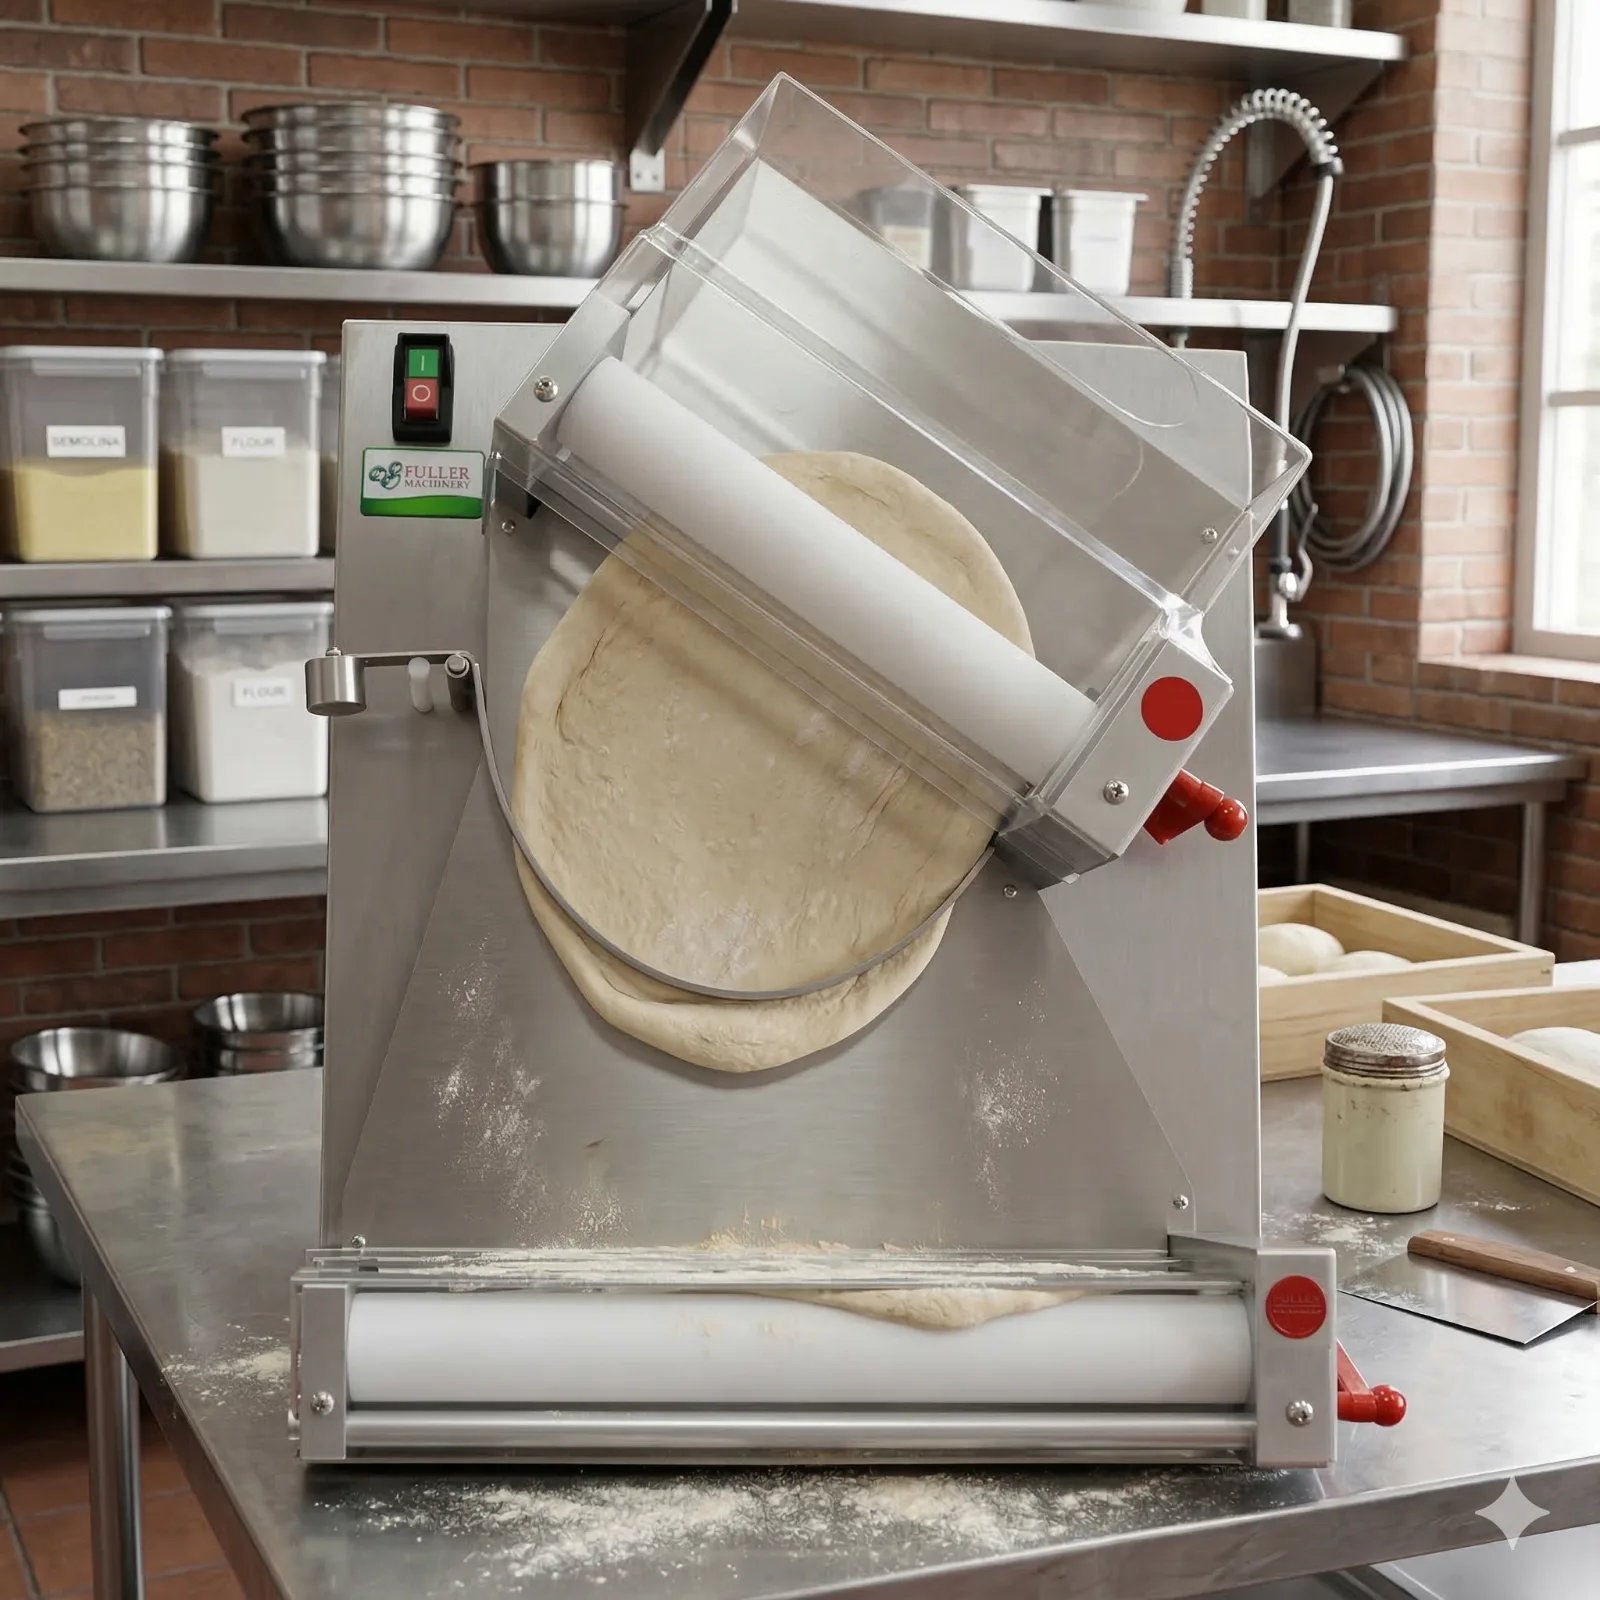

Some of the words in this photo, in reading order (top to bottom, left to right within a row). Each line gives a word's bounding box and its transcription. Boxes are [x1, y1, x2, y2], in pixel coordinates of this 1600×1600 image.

[52, 436, 120, 448] SEMOLINA
[232, 436, 275, 448] FLOUR
[405, 465, 470, 480] FULLER
[404, 480, 471, 490] MACHINERY
[243, 685, 285, 699] FLOUR
